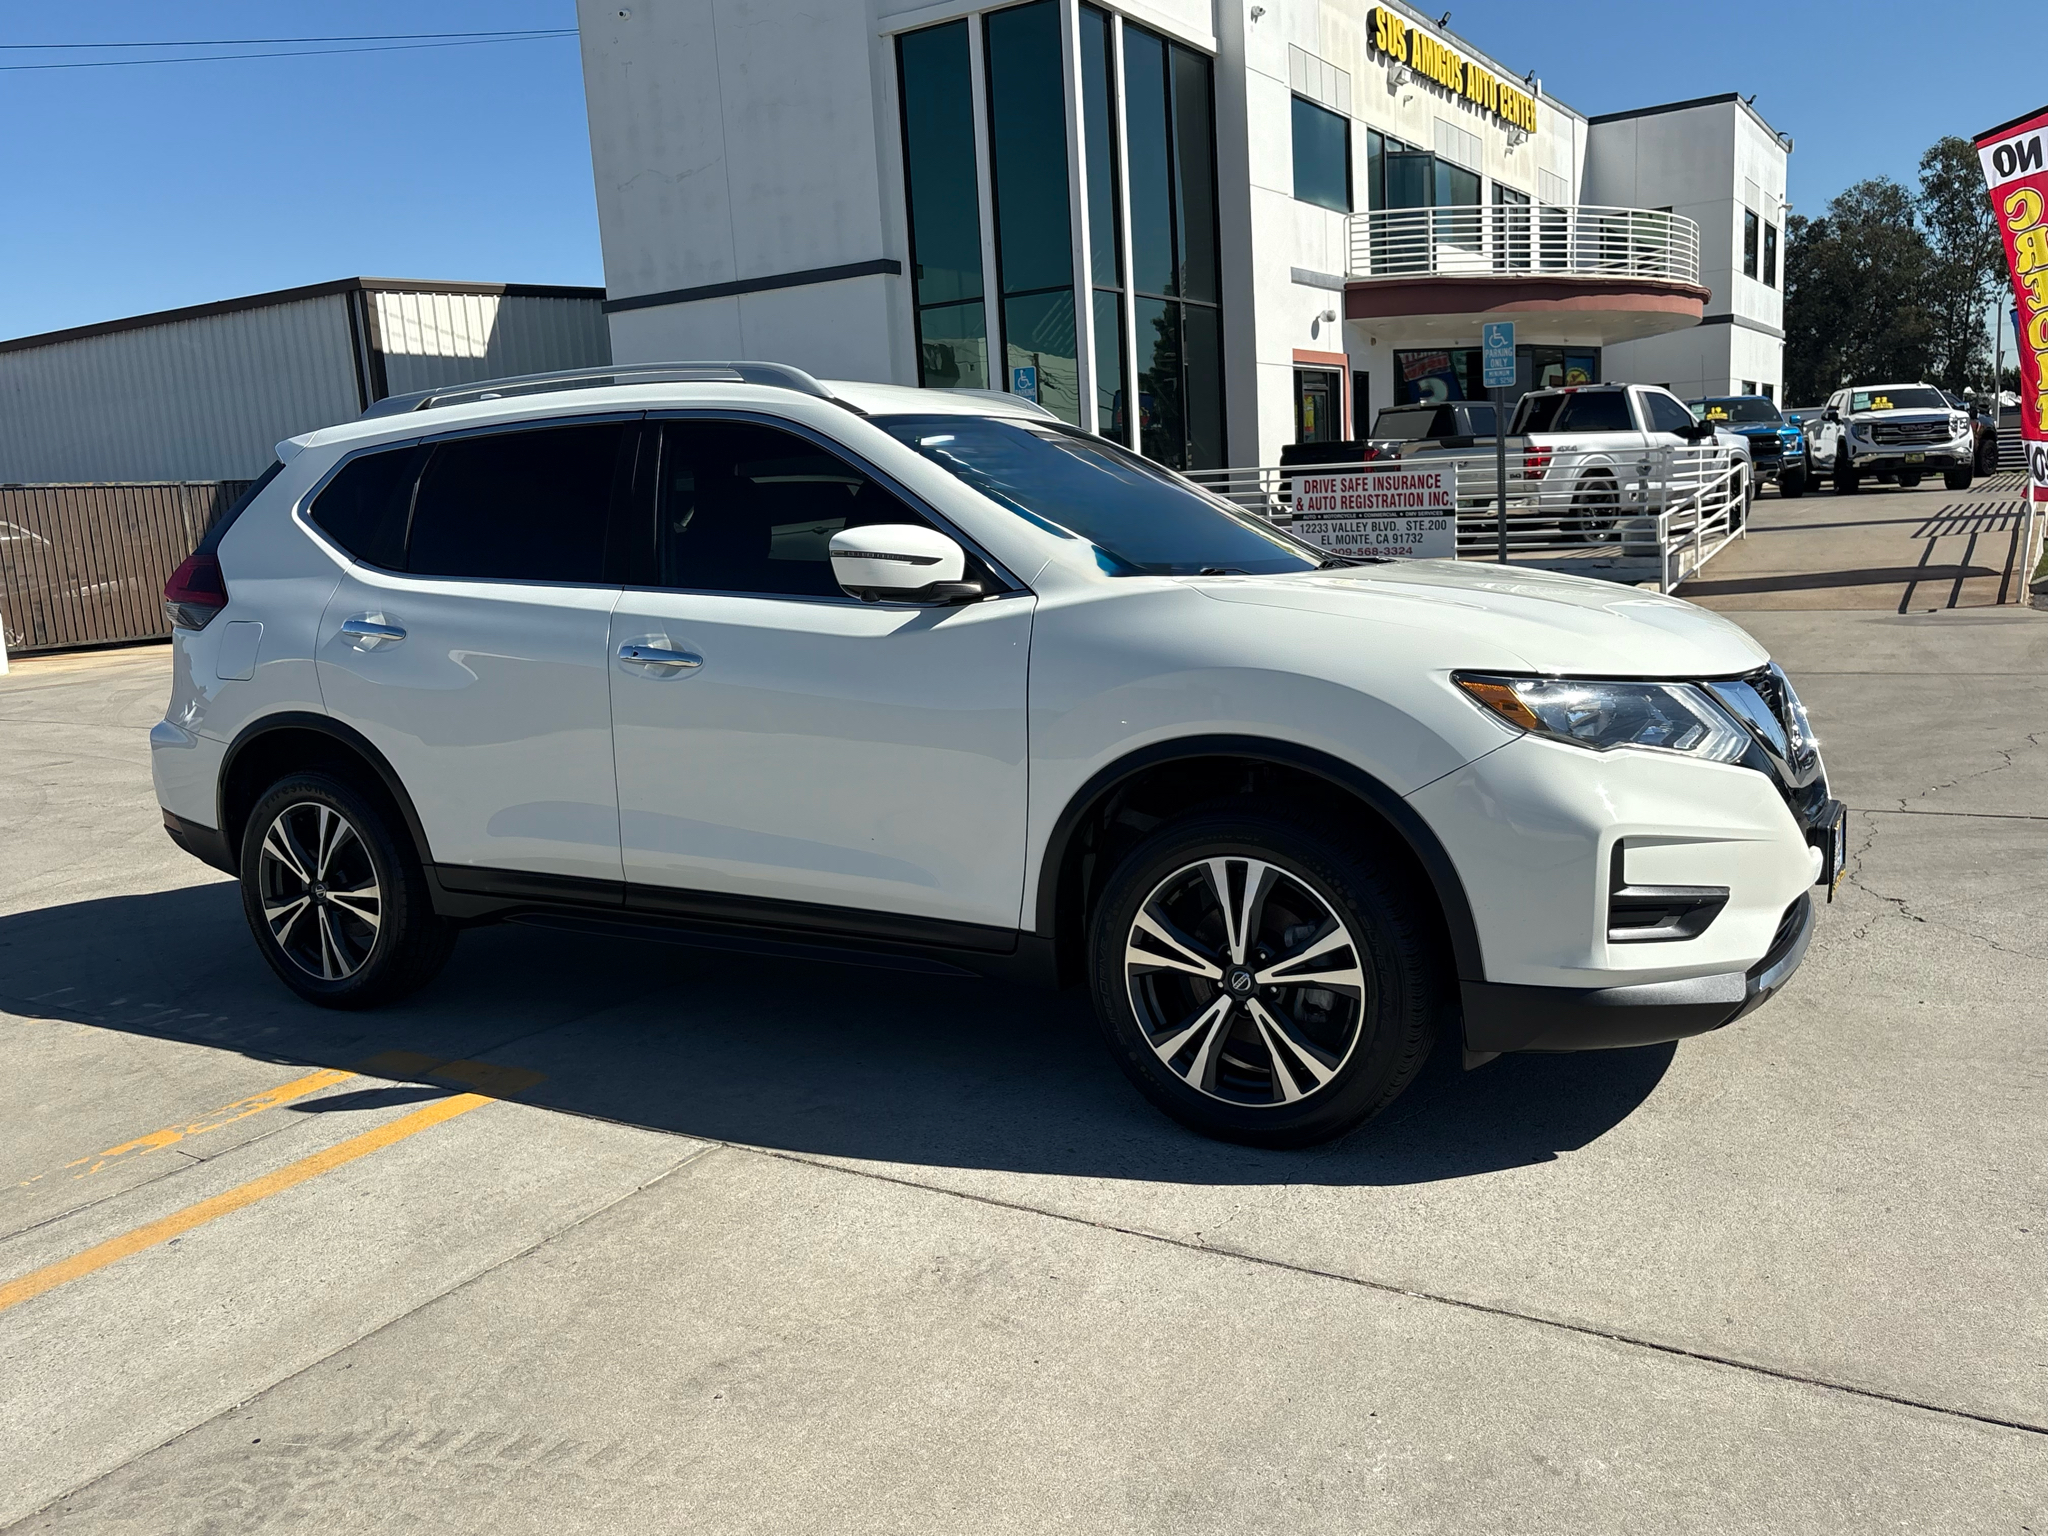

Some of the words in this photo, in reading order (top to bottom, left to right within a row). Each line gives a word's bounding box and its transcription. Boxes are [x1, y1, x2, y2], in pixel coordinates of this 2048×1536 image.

[1375, 6, 1407, 63] SUS
[1411, 29, 1463, 95] AMIGOS
[1466, 62, 1497, 112] AUTO
[1499, 83, 1537, 134] CENTER
[1485, 347, 1512, 357] PARKING
[1491, 358, 1507, 367] ONLY
[1304, 479, 1337, 494] DRIVE
[1340, 477, 1368, 492] SAFE
[1372, 473, 1441, 491] INSURANCE
[1296, 497, 1304, 511] &
[1308, 496, 1337, 511] AUTO
[1340, 492, 1424, 510] REGISTRATION
[1429, 491, 1453, 507] INC.
[1300, 523, 1329, 534] 12233
[1331, 521, 1368, 533] VALLEY
[1372, 521, 1400, 532] BLVD.
[1321, 535, 1332, 545] EL
[1335, 534, 1373, 546] MONTE,
[1376, 533, 1388, 544] CA
[1392, 533, 1423, 544] 91732
[1331, 546, 1413, 556] 909-568-3324
